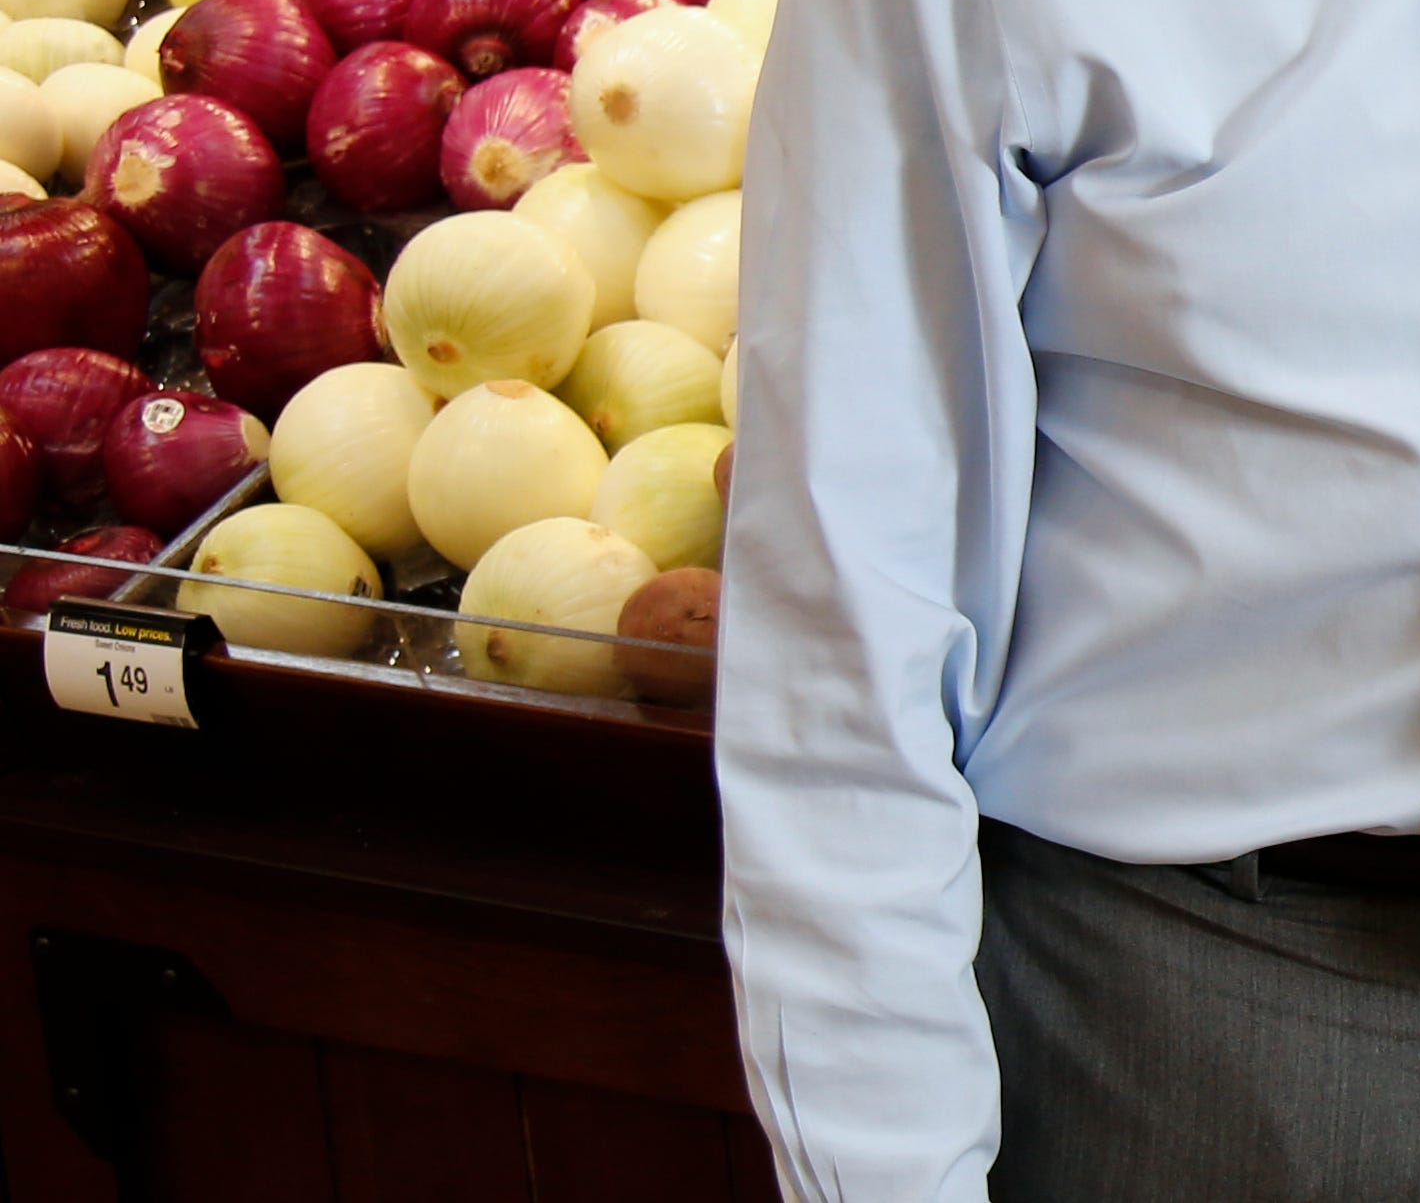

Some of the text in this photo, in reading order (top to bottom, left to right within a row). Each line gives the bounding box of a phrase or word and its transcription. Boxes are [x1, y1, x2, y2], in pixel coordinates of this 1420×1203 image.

[60, 616, 173, 642] Fresh food. Low prices.
[96, 661, 120, 708] 1
[121, 665, 148, 694] 49
